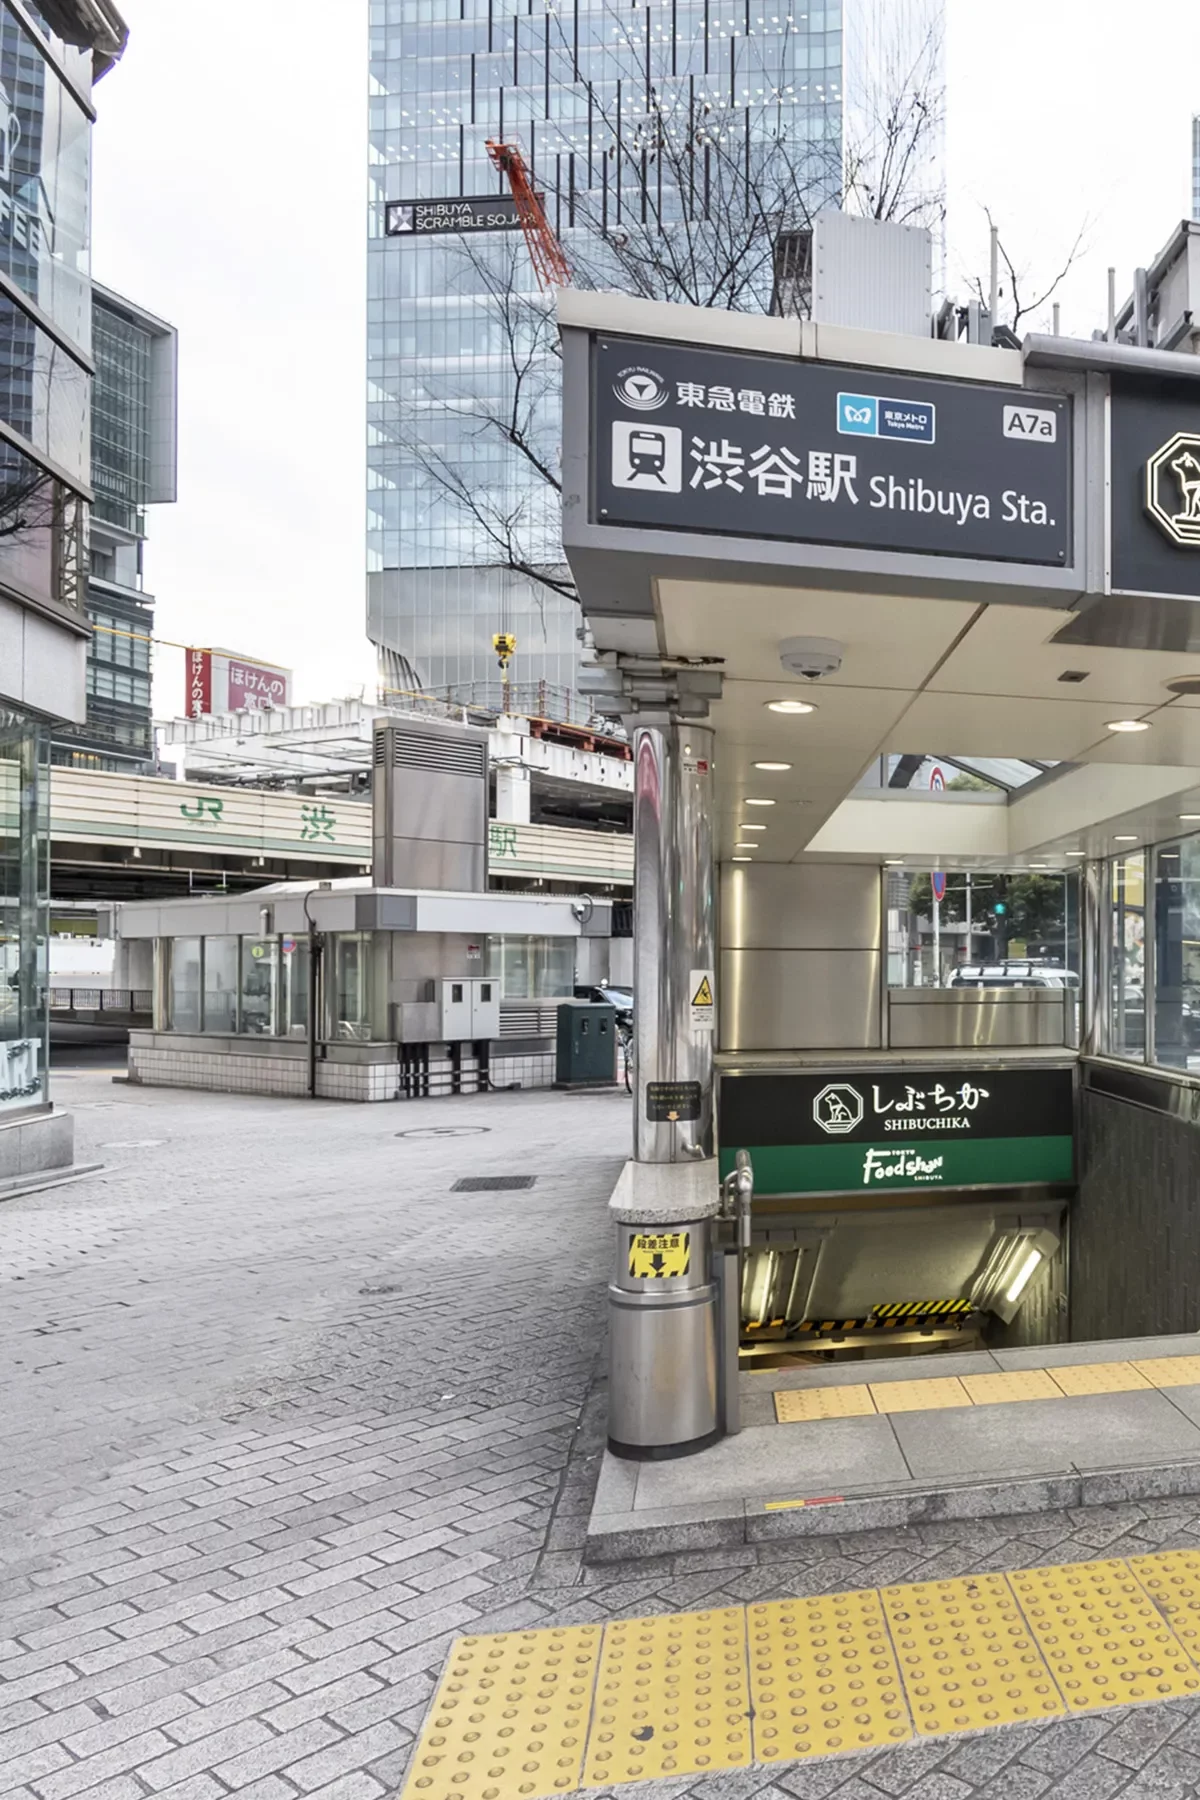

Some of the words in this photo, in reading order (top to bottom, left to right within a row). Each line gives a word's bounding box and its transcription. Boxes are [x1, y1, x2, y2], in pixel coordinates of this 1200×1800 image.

[415, 203, 473, 217] SHIBUYA
[415, 214, 484, 230] SCRAMBLE
[676, 381, 797, 420] 東急電鉄
[884, 410, 928, 424] 東京メトロ
[887, 419, 906, 429] Tokyo
[905, 422, 925, 431] Metro
[1008, 411, 1054, 437] A7a
[688, 435, 860, 506] 渋谷駅
[870, 475, 991, 525] Shibuya
[1002, 490, 1056, 527] Sta.
[231, 667, 284, 696] ほけんの
[180, 796, 224, 821] JR
[872, 1082, 989, 1113] しぶちか
[884, 1117, 971, 1131] SHIBUCHIKA
